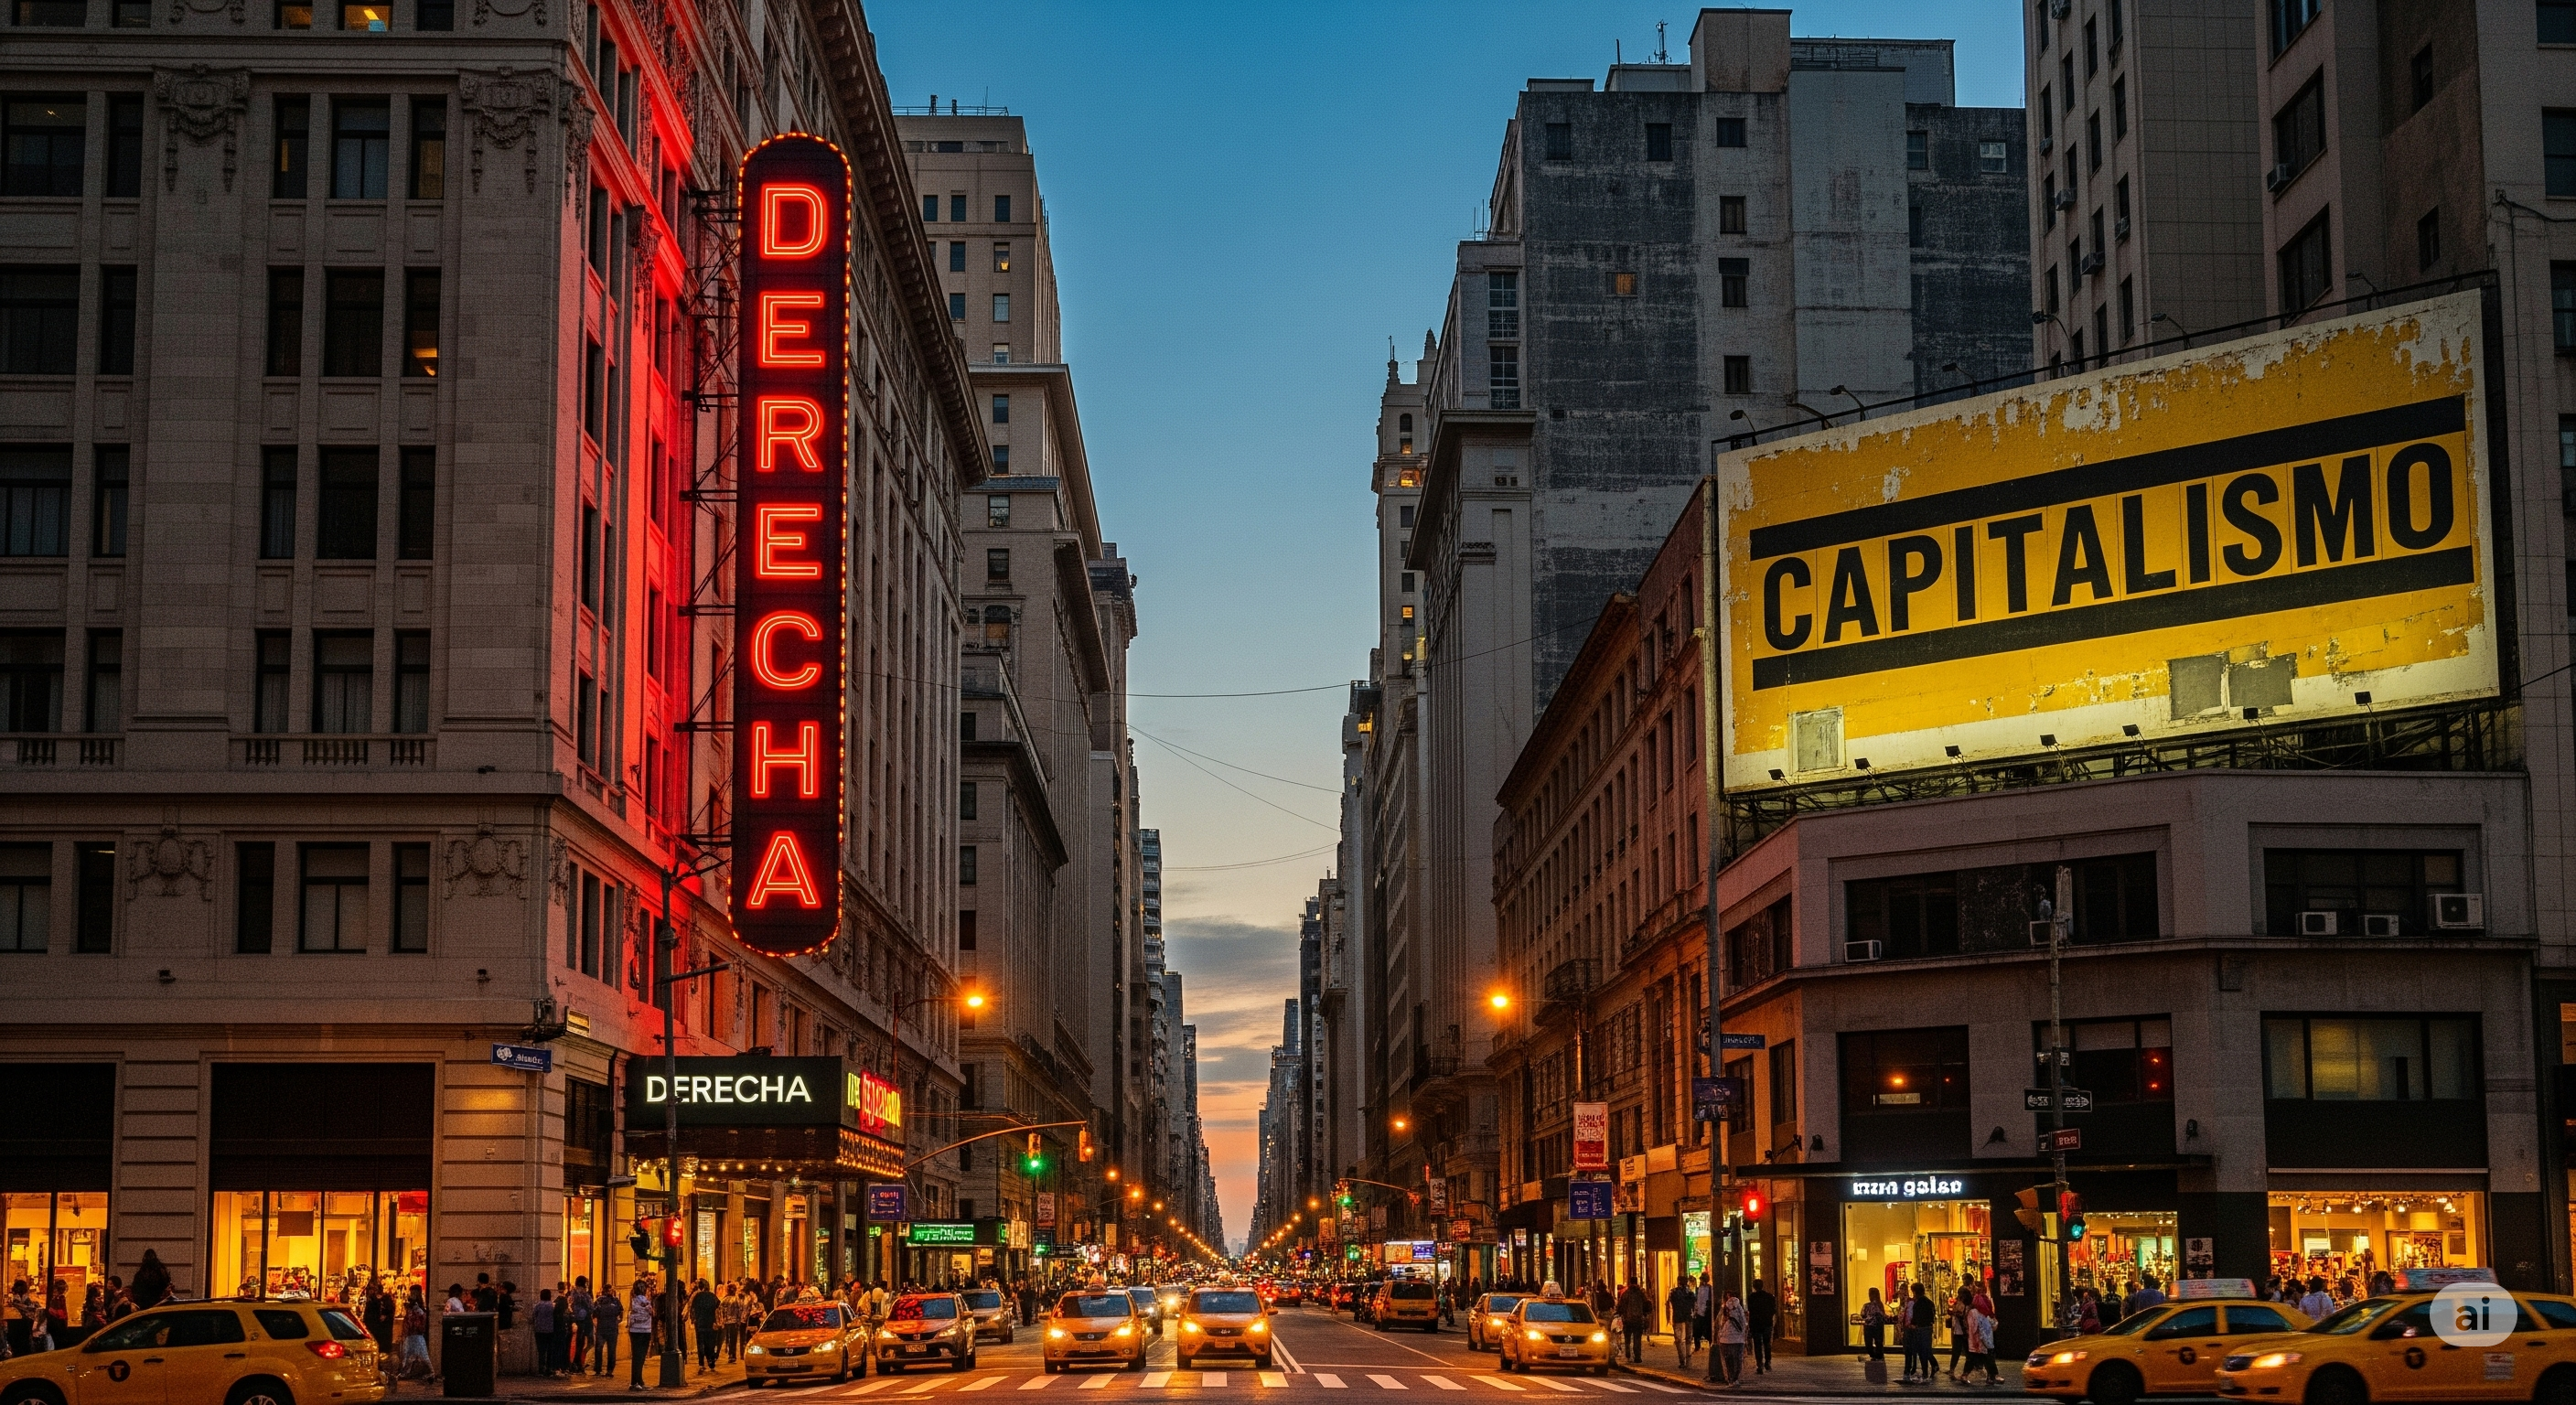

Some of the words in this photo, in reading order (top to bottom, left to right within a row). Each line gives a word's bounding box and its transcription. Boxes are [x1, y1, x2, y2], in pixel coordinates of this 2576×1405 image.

[746, 183, 828, 909] DERECHA
[1763, 443, 2454, 651] CAPITALISMO
[646, 1075, 812, 1103] DERECHA
